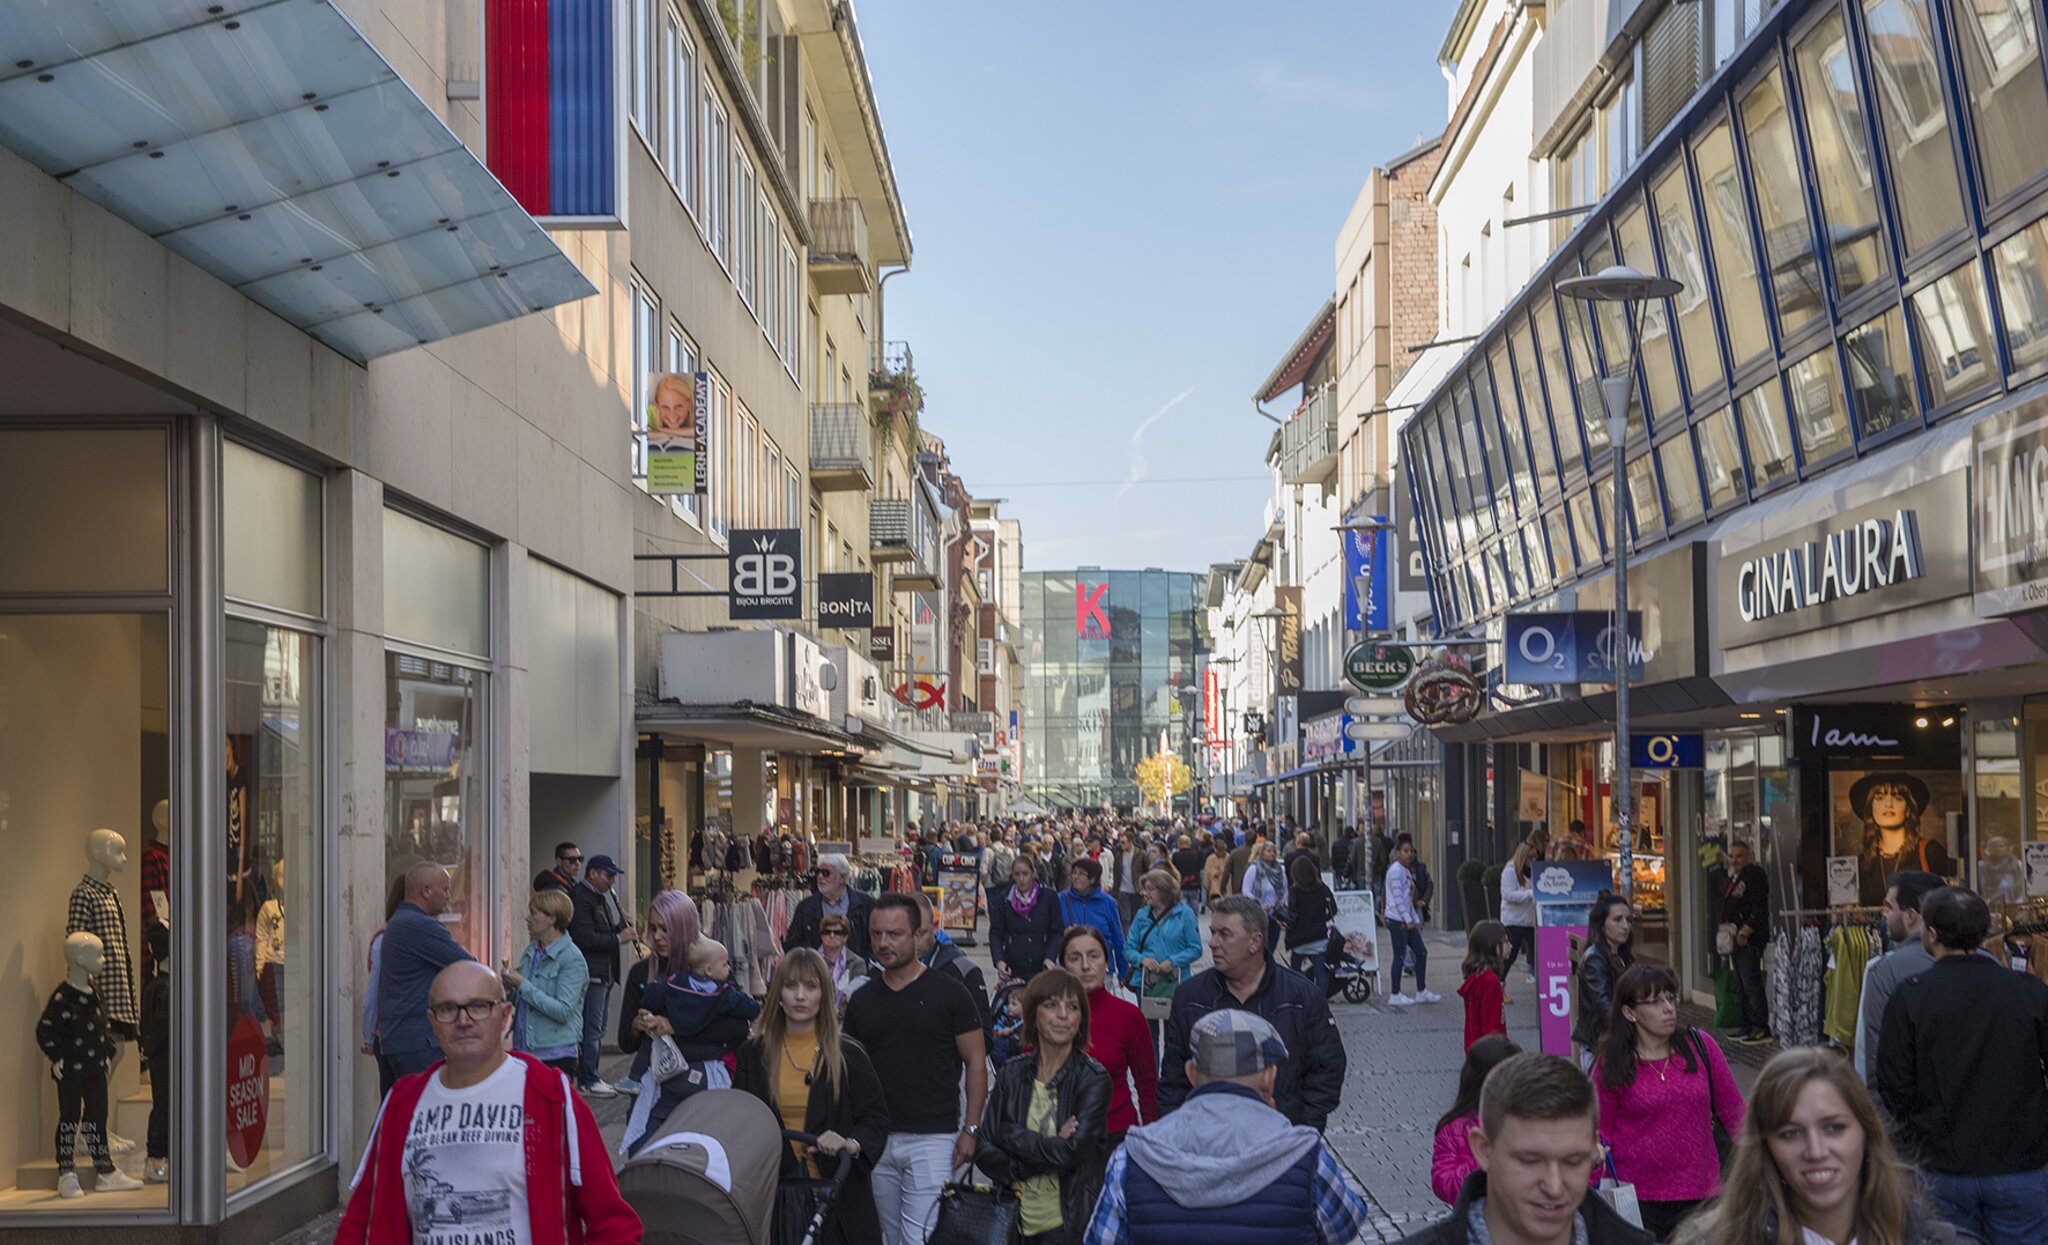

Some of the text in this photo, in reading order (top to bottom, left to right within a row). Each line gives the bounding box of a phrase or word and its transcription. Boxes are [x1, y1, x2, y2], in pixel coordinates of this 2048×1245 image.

[695, 379, 707, 488] LERN ACADEMY
[1738, 509, 1918, 622] GINA LAURA
[736, 597, 794, 608] BIJOU BRIGITTE
[819, 598, 872, 617] BONITA
[1076, 583, 1112, 632] K
[1353, 660, 1408, 674] BECK'S
[978, 758, 996, 771] dm
[239, 1053, 255, 1079] MID
[230, 1075, 264, 1108] SEASON
[236, 1102, 258, 1130] SALE
[413, 1102, 523, 1136] AMP DAVID
